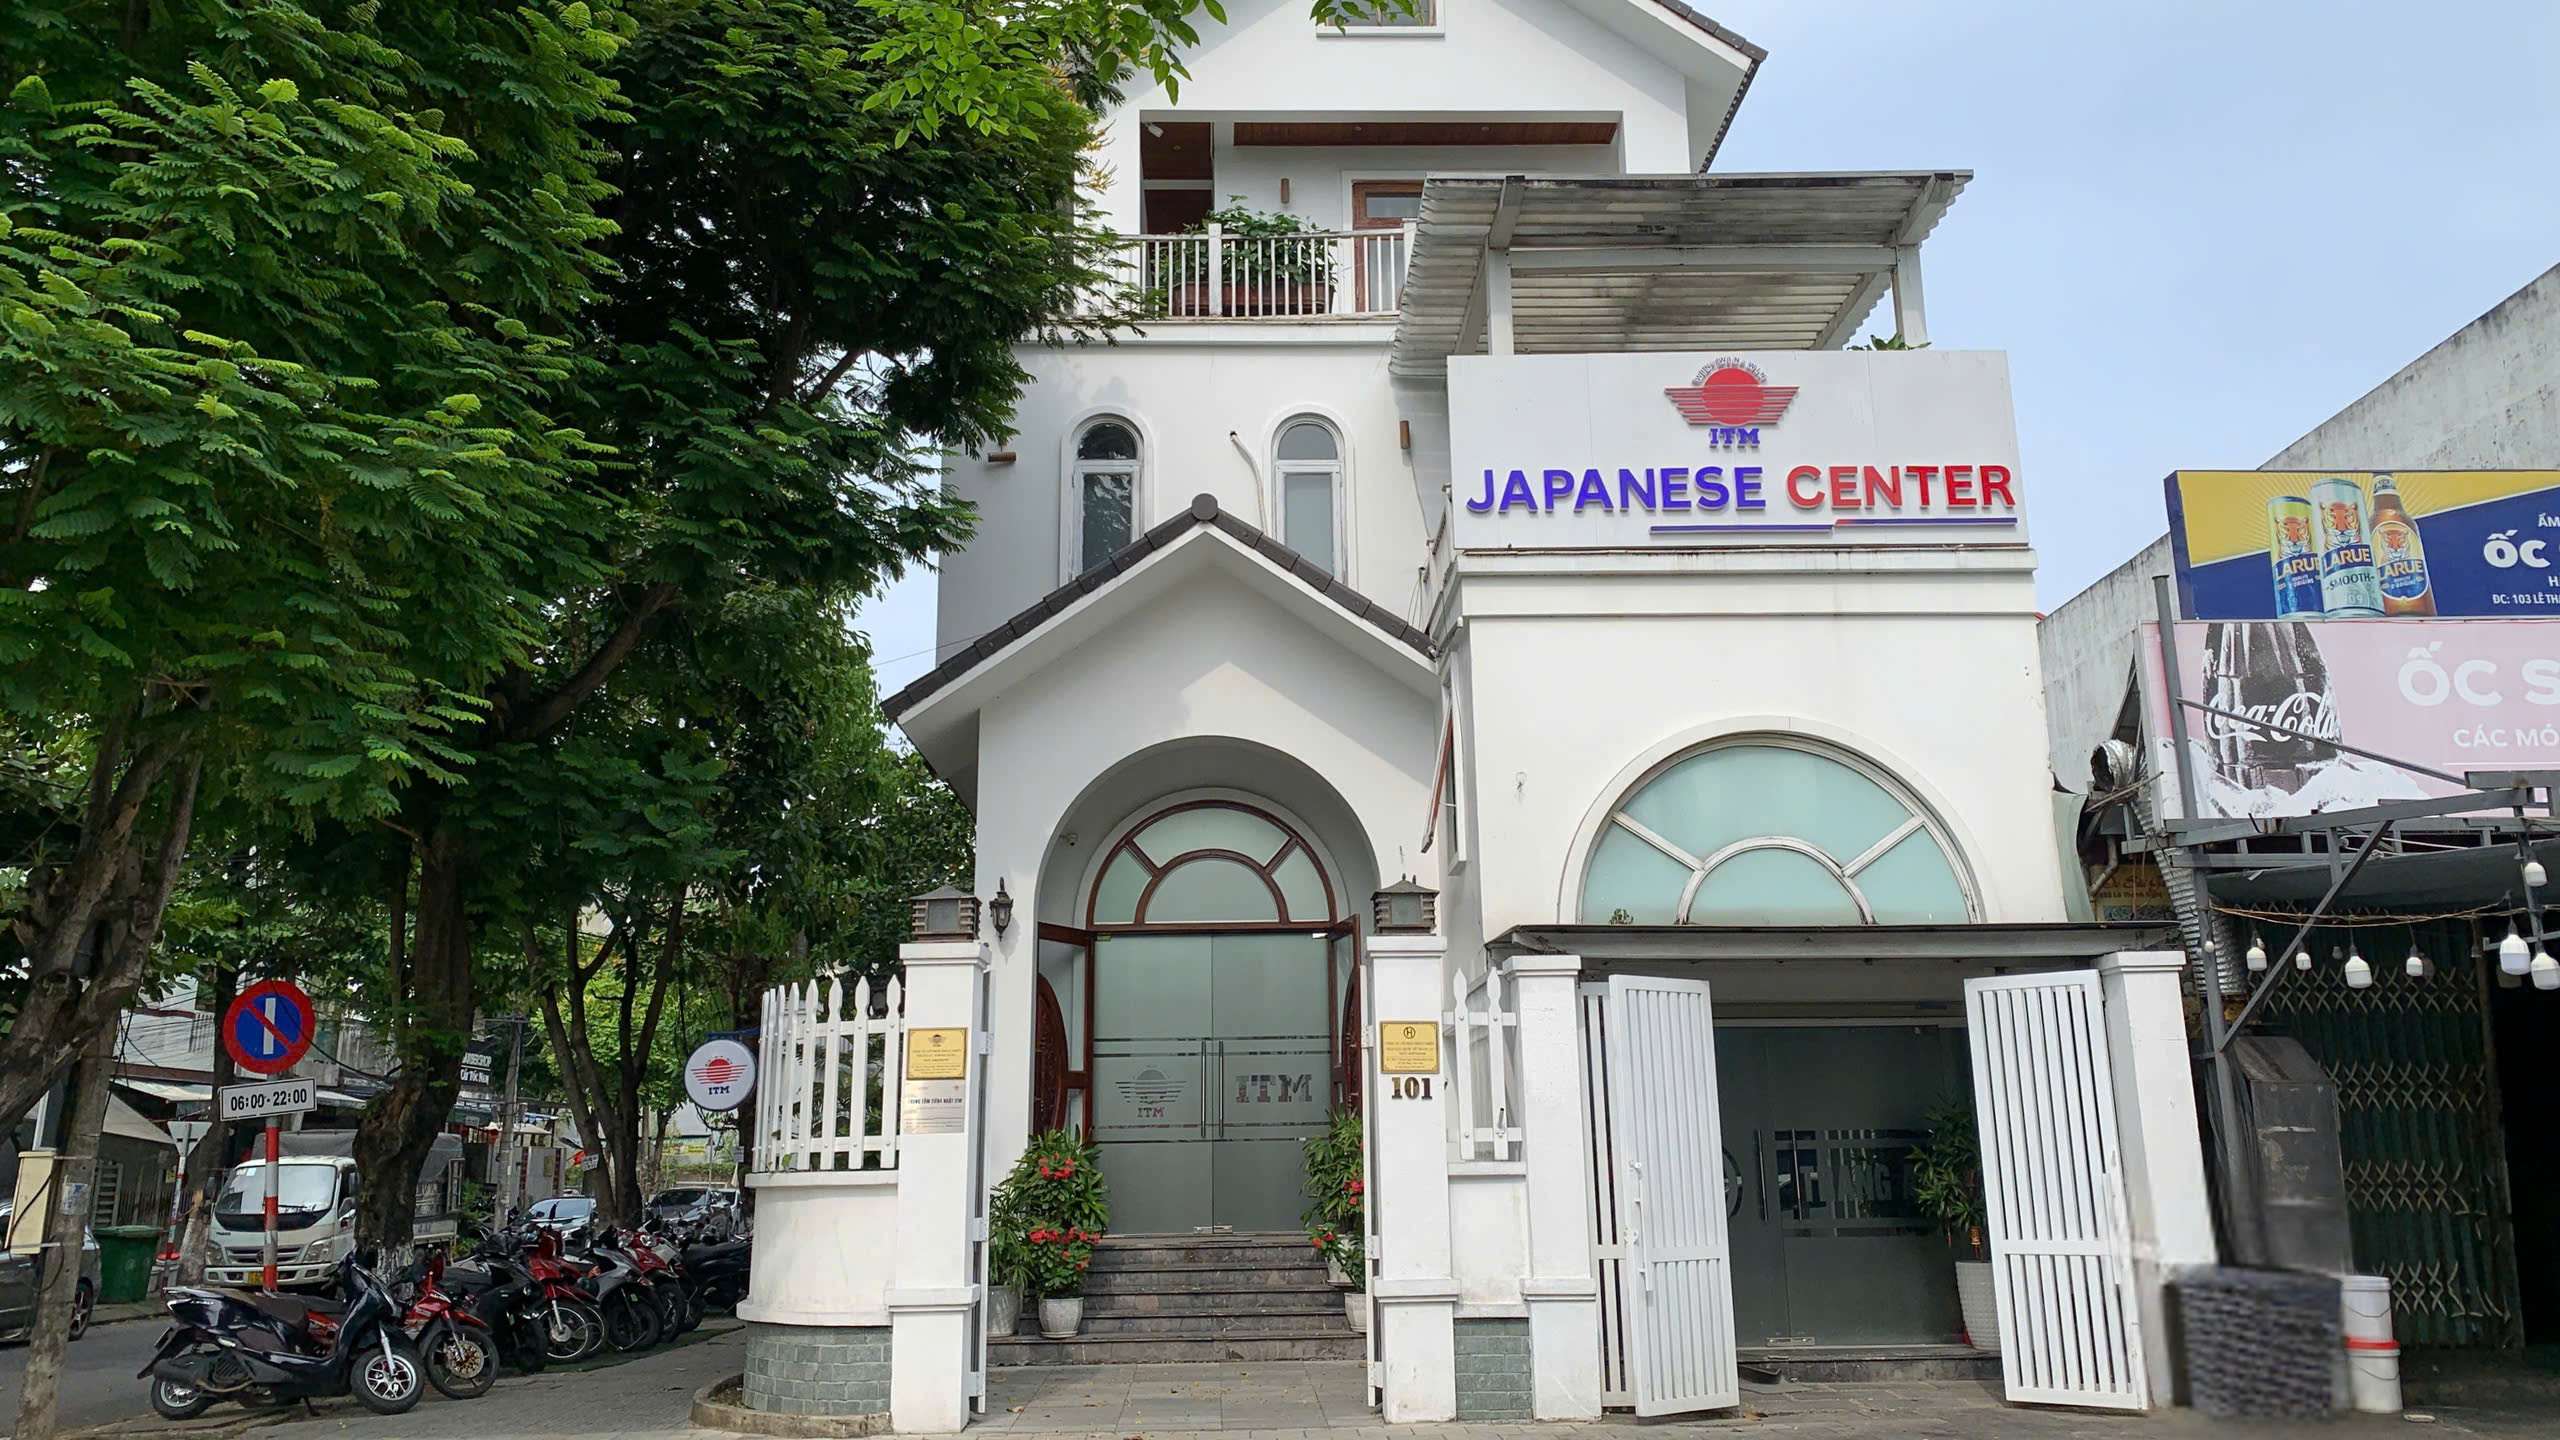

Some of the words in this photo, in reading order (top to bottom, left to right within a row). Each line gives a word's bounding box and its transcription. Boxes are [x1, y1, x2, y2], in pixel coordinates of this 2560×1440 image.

[1709, 427, 1761, 446] ITM
[1466, 466, 1767, 514] JAPANESE
[1785, 464, 2016, 511] CENTER
[2322, 548, 2371, 573] LARUE
[2483, 529, 2551, 568] ỐC
[2328, 573, 2371, 591] SMOOTH
[2377, 560, 2424, 580] LARUE
[2511, 593, 2532, 605] 103
[2545, 593, 2560, 605] TH
[2398, 641, 2503, 706] ỐC
[2453, 724, 2508, 748] CÁC
[708, 1086, 730, 1095] ITM
[1235, 1074, 1313, 1104] ITM
[1391, 1076, 1433, 1100] 101
[1137, 1107, 1165, 1118] ITM
